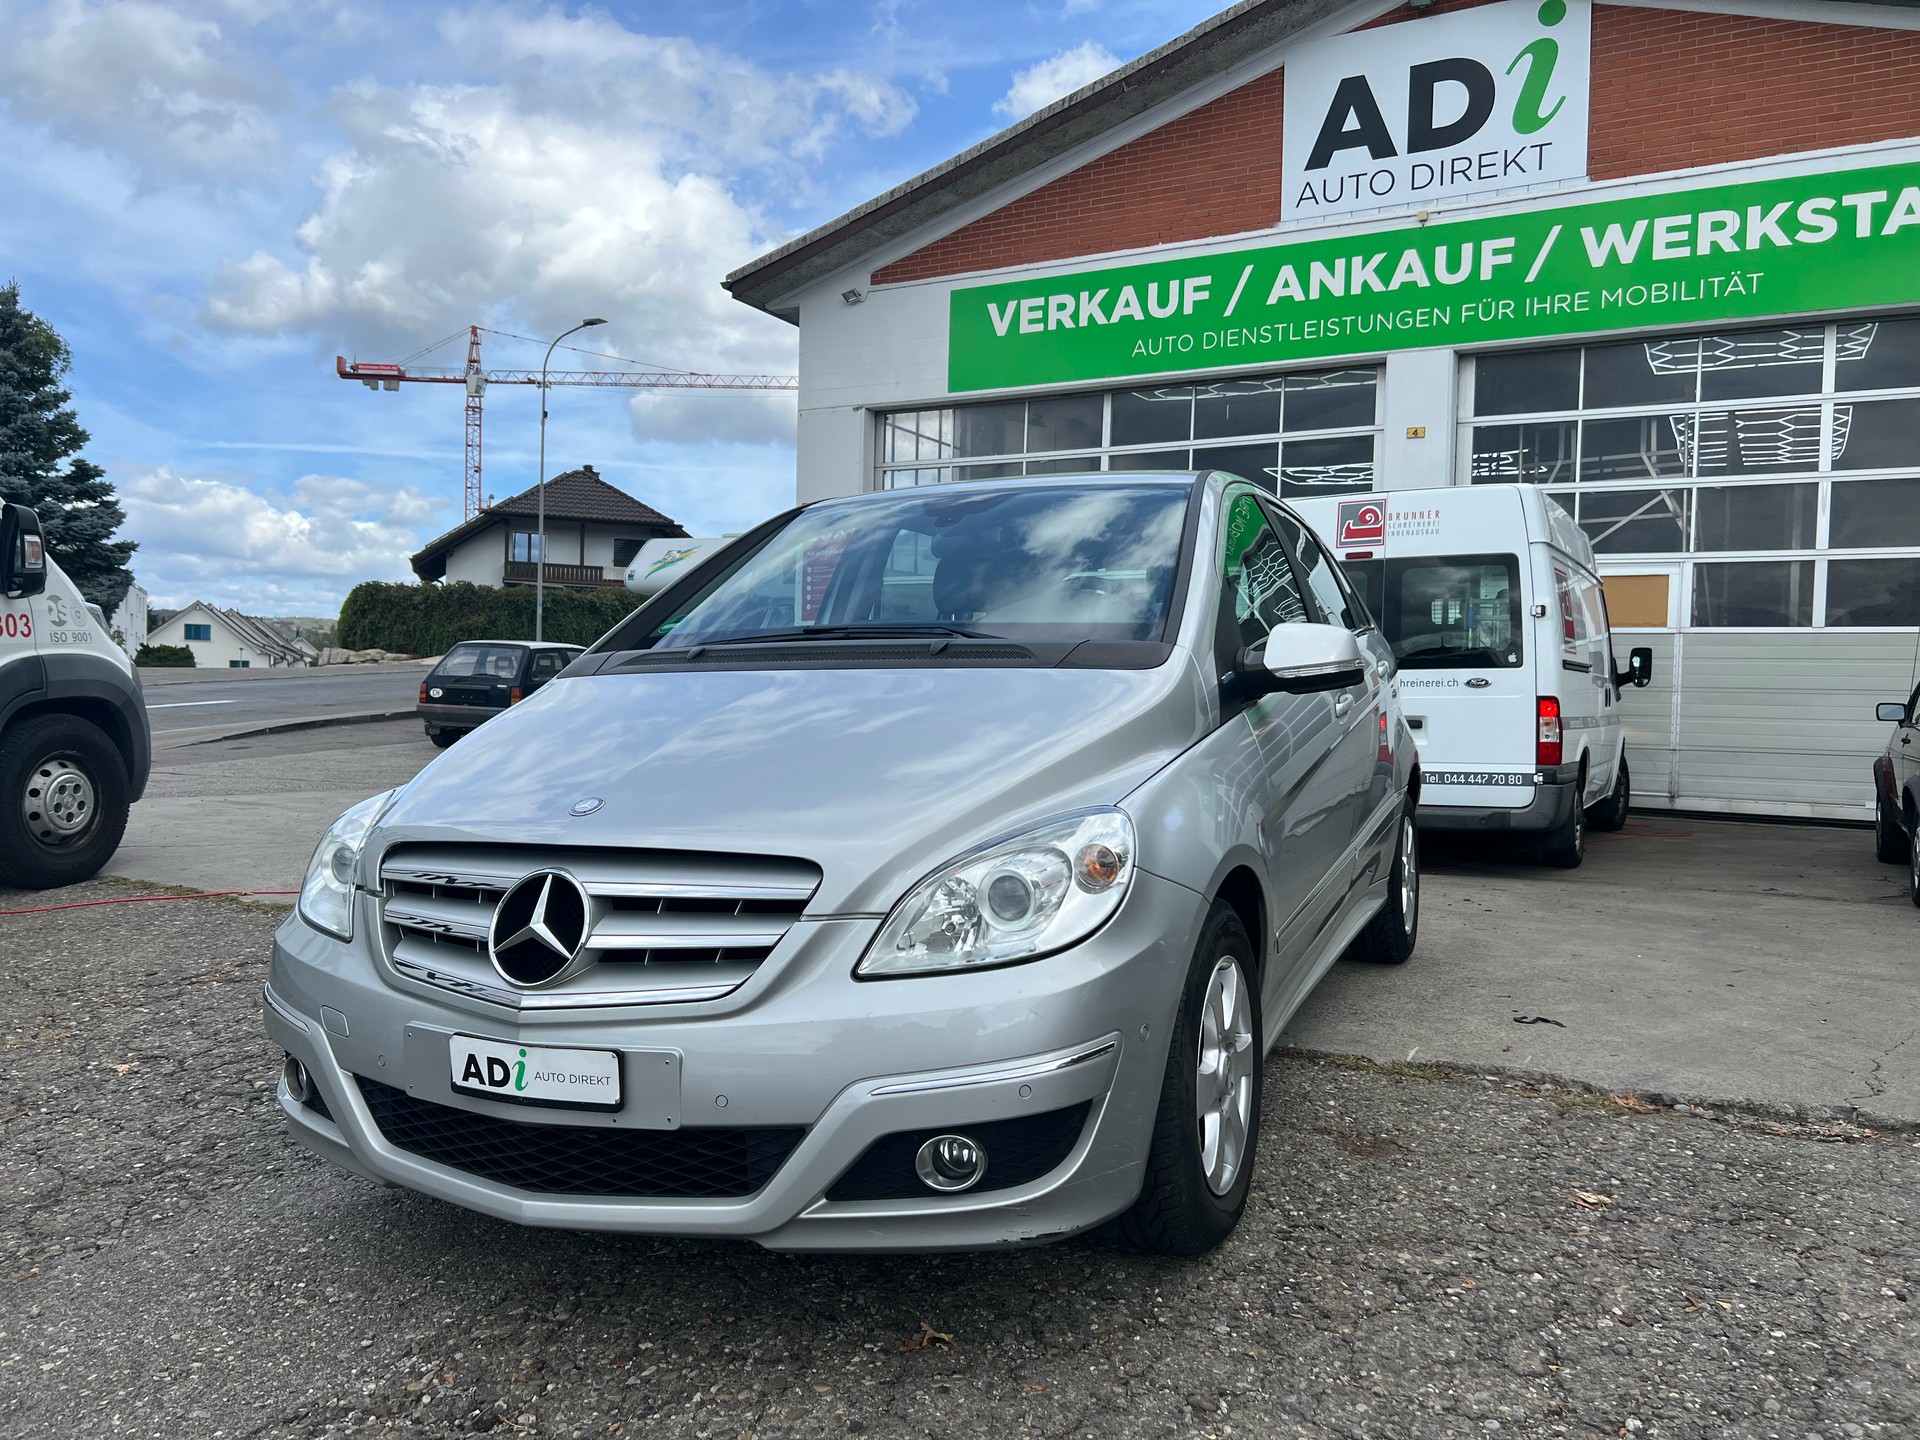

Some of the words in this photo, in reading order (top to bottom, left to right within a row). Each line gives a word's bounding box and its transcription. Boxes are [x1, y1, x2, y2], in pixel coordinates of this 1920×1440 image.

[1304, 0, 1566, 170] ADi
[1296, 168, 1396, 208] AUTO
[1410, 142, 1552, 191] DIREKT
[986, 276, 1212, 337] VERKAUF
[1223, 264, 1253, 317] /
[1266, 236, 1516, 305] ANKAUF
[1524, 225, 1562, 283] /
[1580, 186, 1920, 268] WERKSTA
[1131, 334, 1194, 357] AUTO
[1202, 307, 1451, 348] DIENSTLEISTUNGEN
[1461, 298, 1516, 324] FÜR
[1524, 290, 1591, 317] IHRE
[1601, 271, 1764, 310] MOBILITÄT
[1412, 428, 1418, 437] 4
[1388, 510, 1440, 521] BRUNNER
[1388, 520, 1440, 529] SCHREINEREI
[1387, 528, 1440, 537] INNENAUSBAU
[0, 613, 31, 638] 03
[50, 632, 67, 643] ISO
[72, 632, 92, 642] 9001
[1425, 773, 1441, 784] Tel.
[1444, 773, 1465, 785] 044
[1468, 773, 1488, 785] 447
[1492, 773, 1506, 785] 70
[1508, 774, 1522, 785] 80
[461, 1048, 529, 1091] ADi
[534, 1071, 566, 1083] AUTO
[570, 1074, 611, 1086] DIREKT
